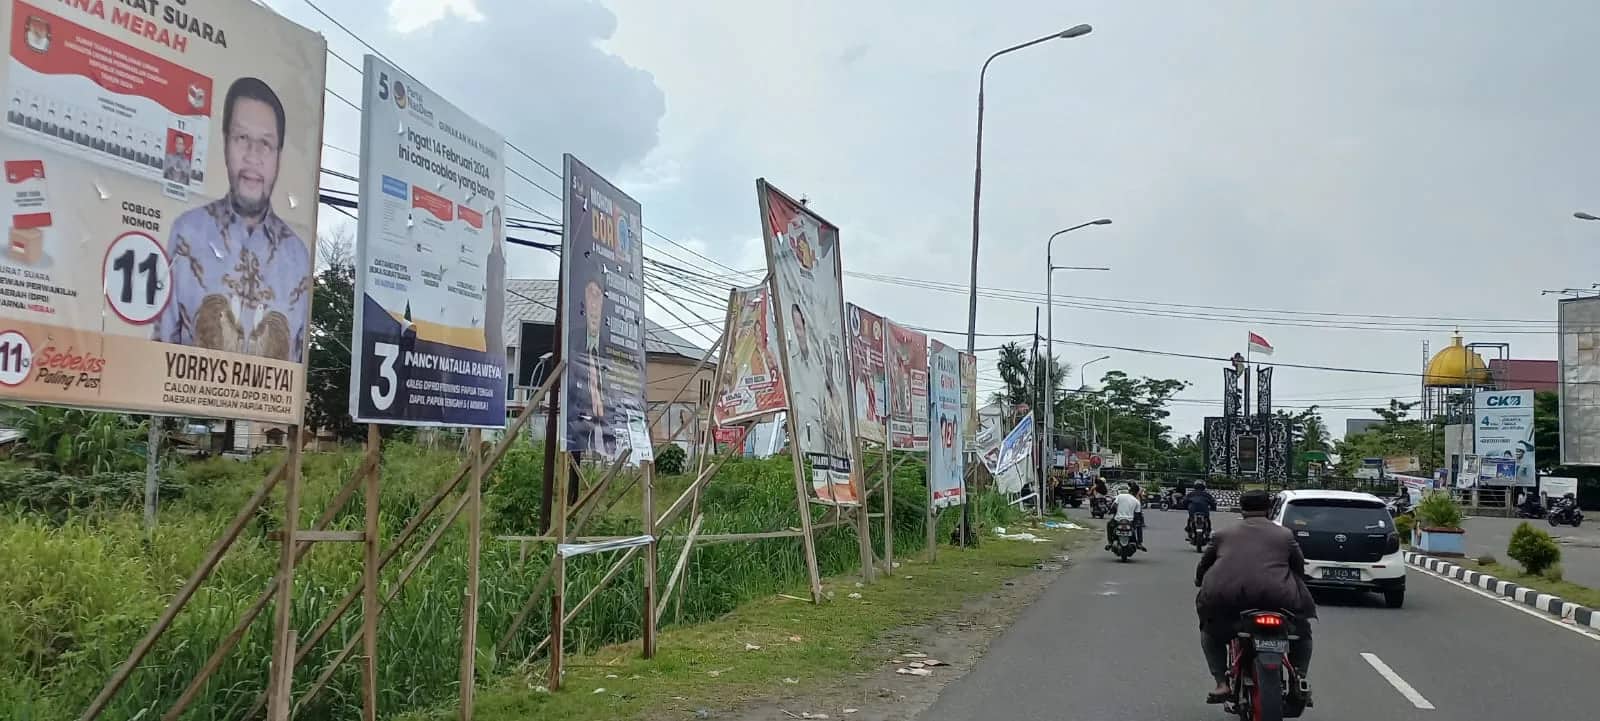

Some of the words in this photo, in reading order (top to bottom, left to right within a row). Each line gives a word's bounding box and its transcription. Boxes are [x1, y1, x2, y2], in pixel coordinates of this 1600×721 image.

[111, 7, 187, 52] MERAH
[163, 5, 227, 48] SUARA
[379, 72, 389, 100] 5
[432, 139, 441, 156] 14
[442, 144, 473, 171] Februari
[399, 144, 410, 162] Ini
[411, 151, 430, 170] cara
[431, 160, 457, 183] coblos
[458, 173, 476, 197] yang
[121, 201, 161, 219] COBLOS
[121, 215, 160, 232] NOMOR
[592, 207, 614, 249] DOA
[24, 270, 50, 281] SUARA
[26, 281, 77, 297] PERWAKILAN
[113, 249, 159, 305] 11
[0, 341, 22, 373] 11
[404, 351, 438, 370] NANCY
[439, 356, 470, 375] NATALIA
[35, 367, 75, 390] Paling
[166, 352, 228, 383] YORRYS
[231, 361, 294, 392] RAWEYAI
[370, 342, 399, 410] 3
[163, 394, 196, 405] DAERAH
[198, 397, 238, 409] PEMILIHAN
[240, 402, 262, 411] PAPUA
[264, 404, 291, 414] TENGAH
[164, 382, 196, 394] CALON
[199, 386, 240, 399] ANGGOTA
[241, 390, 260, 401] DPD
[1481, 415, 1490, 426] 4
